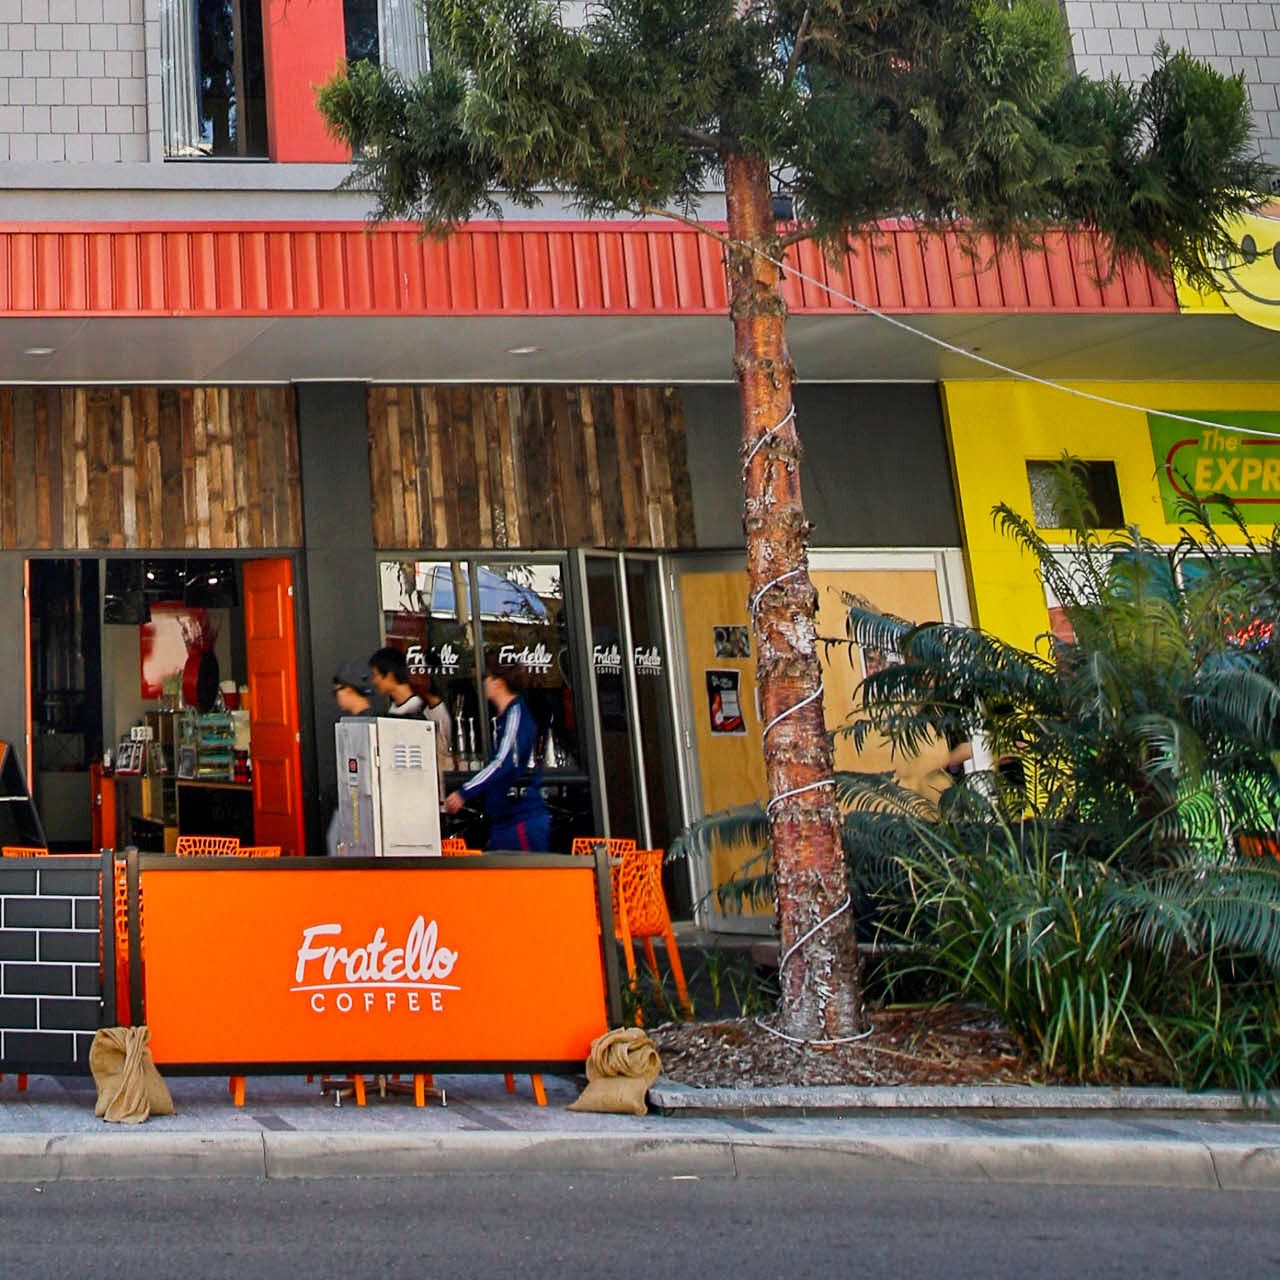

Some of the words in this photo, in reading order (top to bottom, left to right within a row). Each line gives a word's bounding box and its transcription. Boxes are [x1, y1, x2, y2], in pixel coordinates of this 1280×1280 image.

[1202, 429, 1237, 452] The
[406, 643, 459, 664] Frllo
[593, 644, 620, 664] Fratello
[635, 646, 661, 665] Fratello
[295, 915, 458, 983] Fratello
[310, 992, 443, 1012] COFFEE
